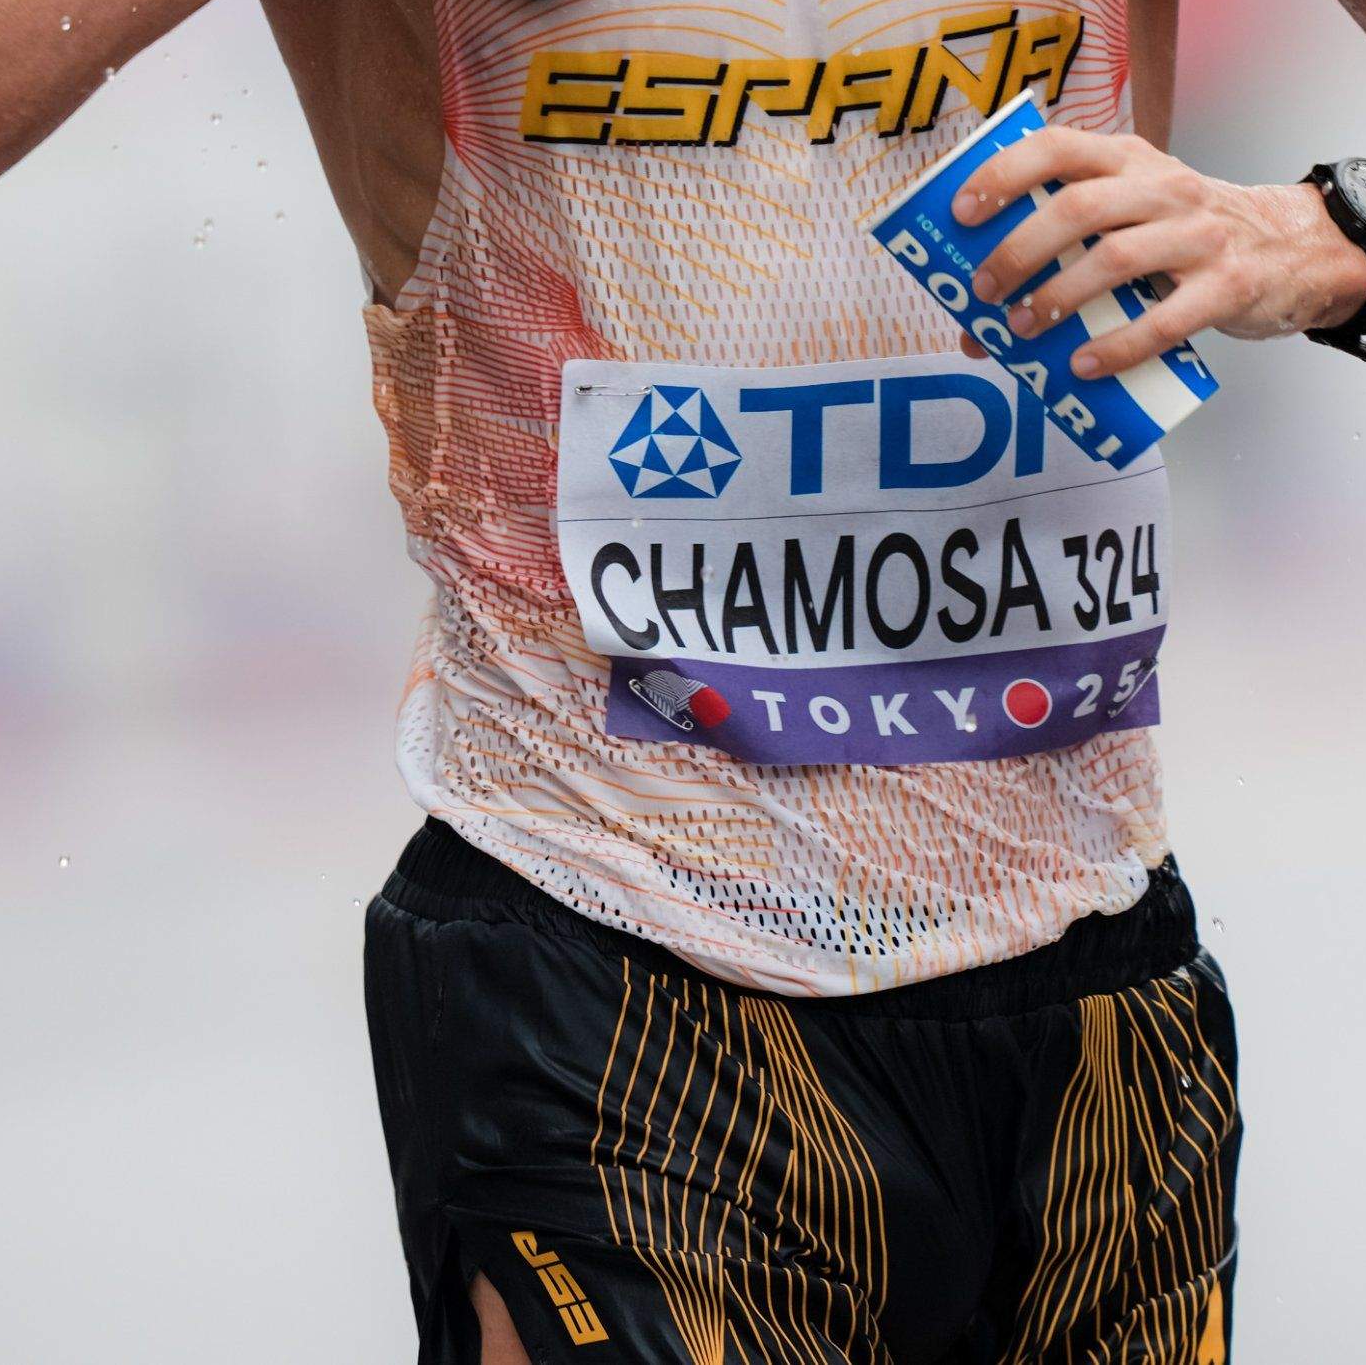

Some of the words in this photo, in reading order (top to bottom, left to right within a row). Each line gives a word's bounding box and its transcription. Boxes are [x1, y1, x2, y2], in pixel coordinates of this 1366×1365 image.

[518, 9, 1085, 147] ESPAÑA
[915, 213, 944, 243] ION
[886, 228, 1124, 460] POCARI
[590, 516, 1052, 656] CHAMOSA
[1061, 522, 1161, 633] 324
[1072, 658, 1145, 719] 25
[510, 1230, 610, 1346] ESP
